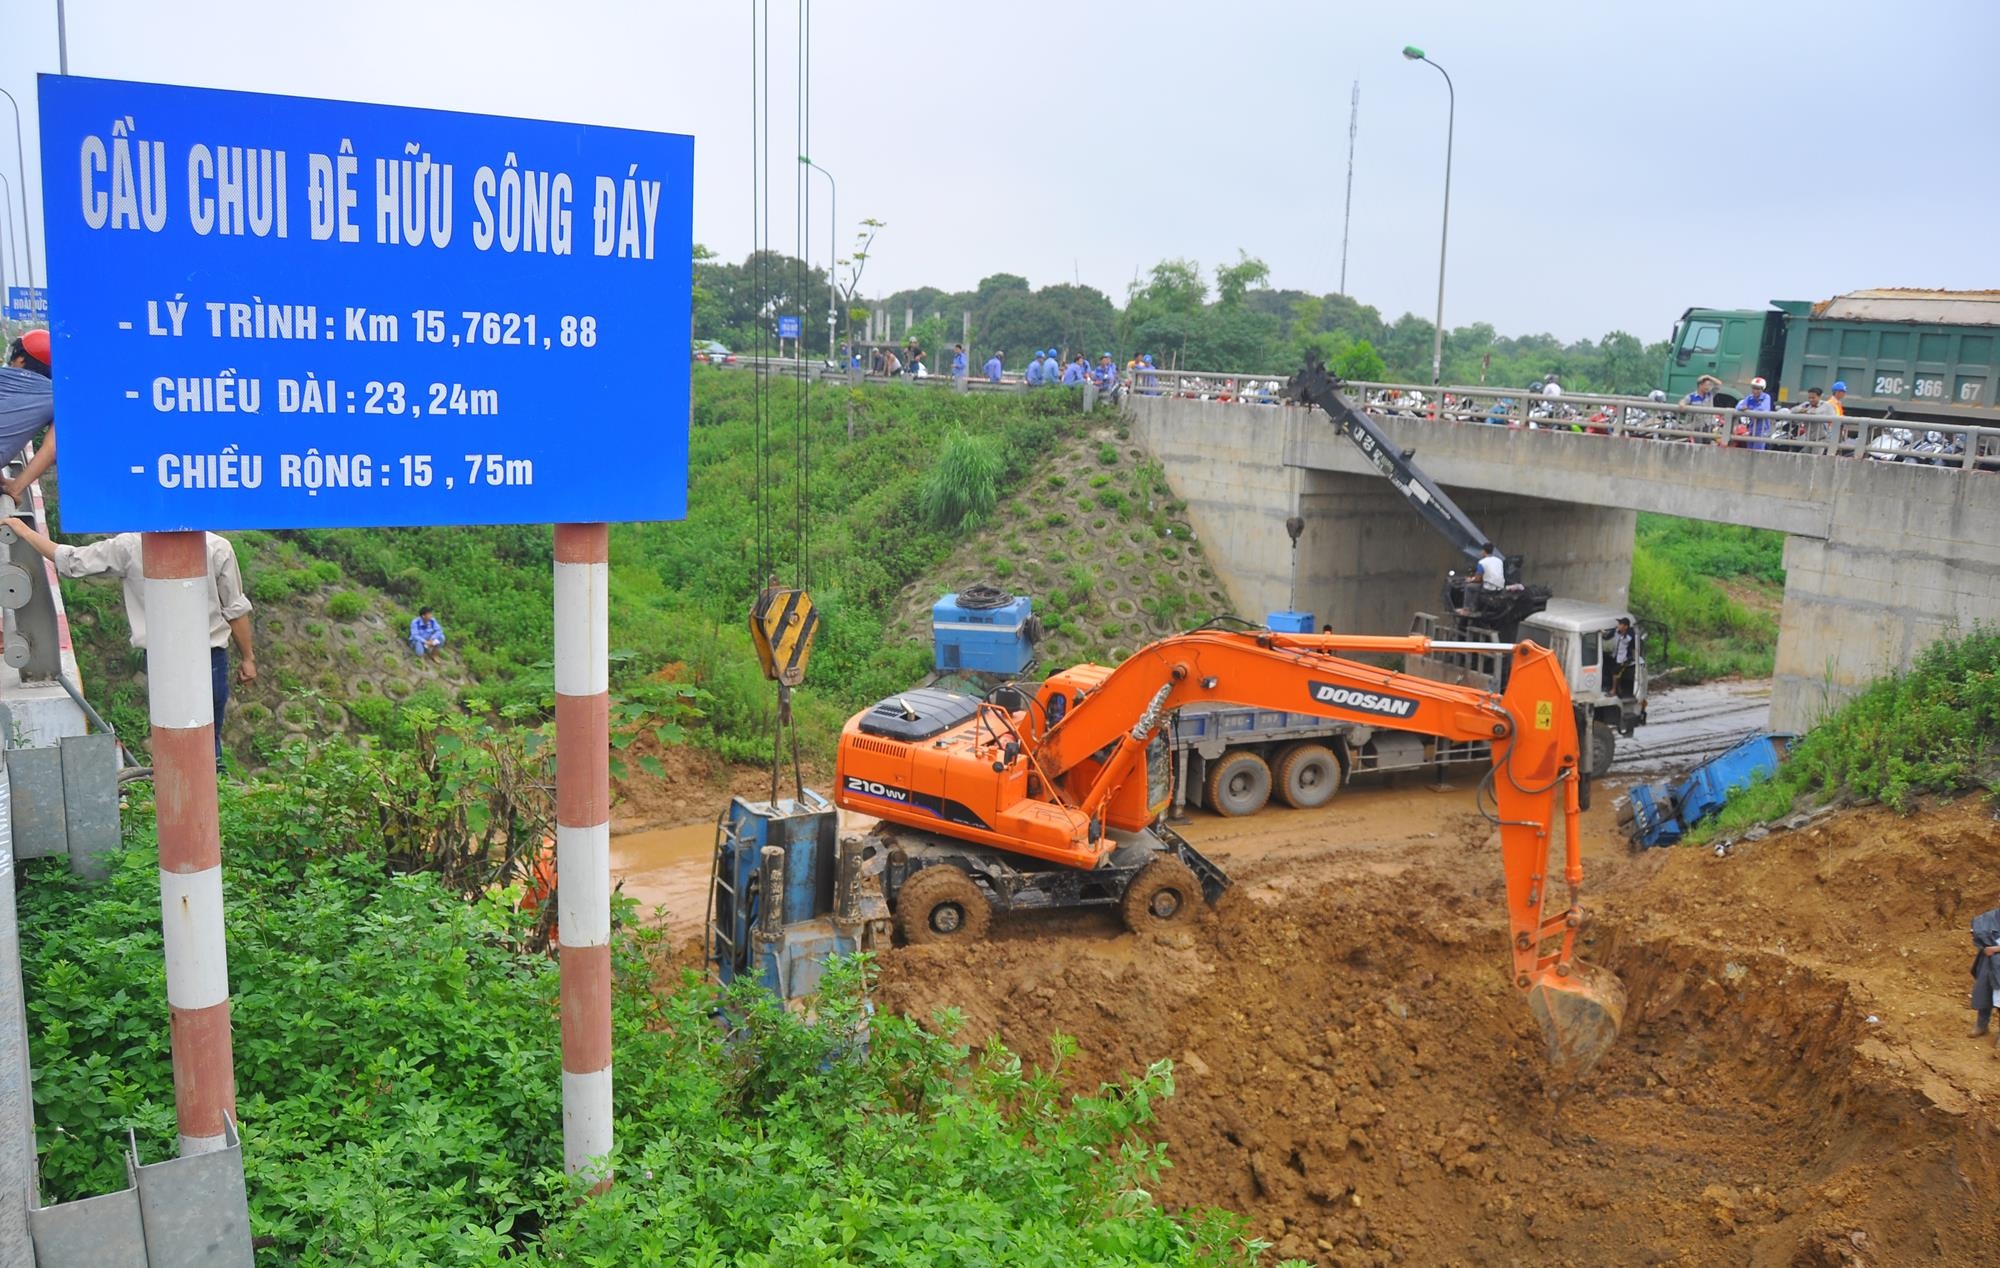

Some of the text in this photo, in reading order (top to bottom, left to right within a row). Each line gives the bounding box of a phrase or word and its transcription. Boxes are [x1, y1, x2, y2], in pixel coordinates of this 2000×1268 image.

[80, 115, 661, 260] CẦU CHUI ĐÊ HỮU SÔNG ĐÁY
[147, 293, 188, 337] LÝ
[345, 307, 398, 342] Km
[152, 367, 260, 413] CHIỀU
[1960, 383, 1981, 400] 67
[157, 444, 262, 489] CHIỀU
[1316, 685, 1410, 716] DOOSAN
